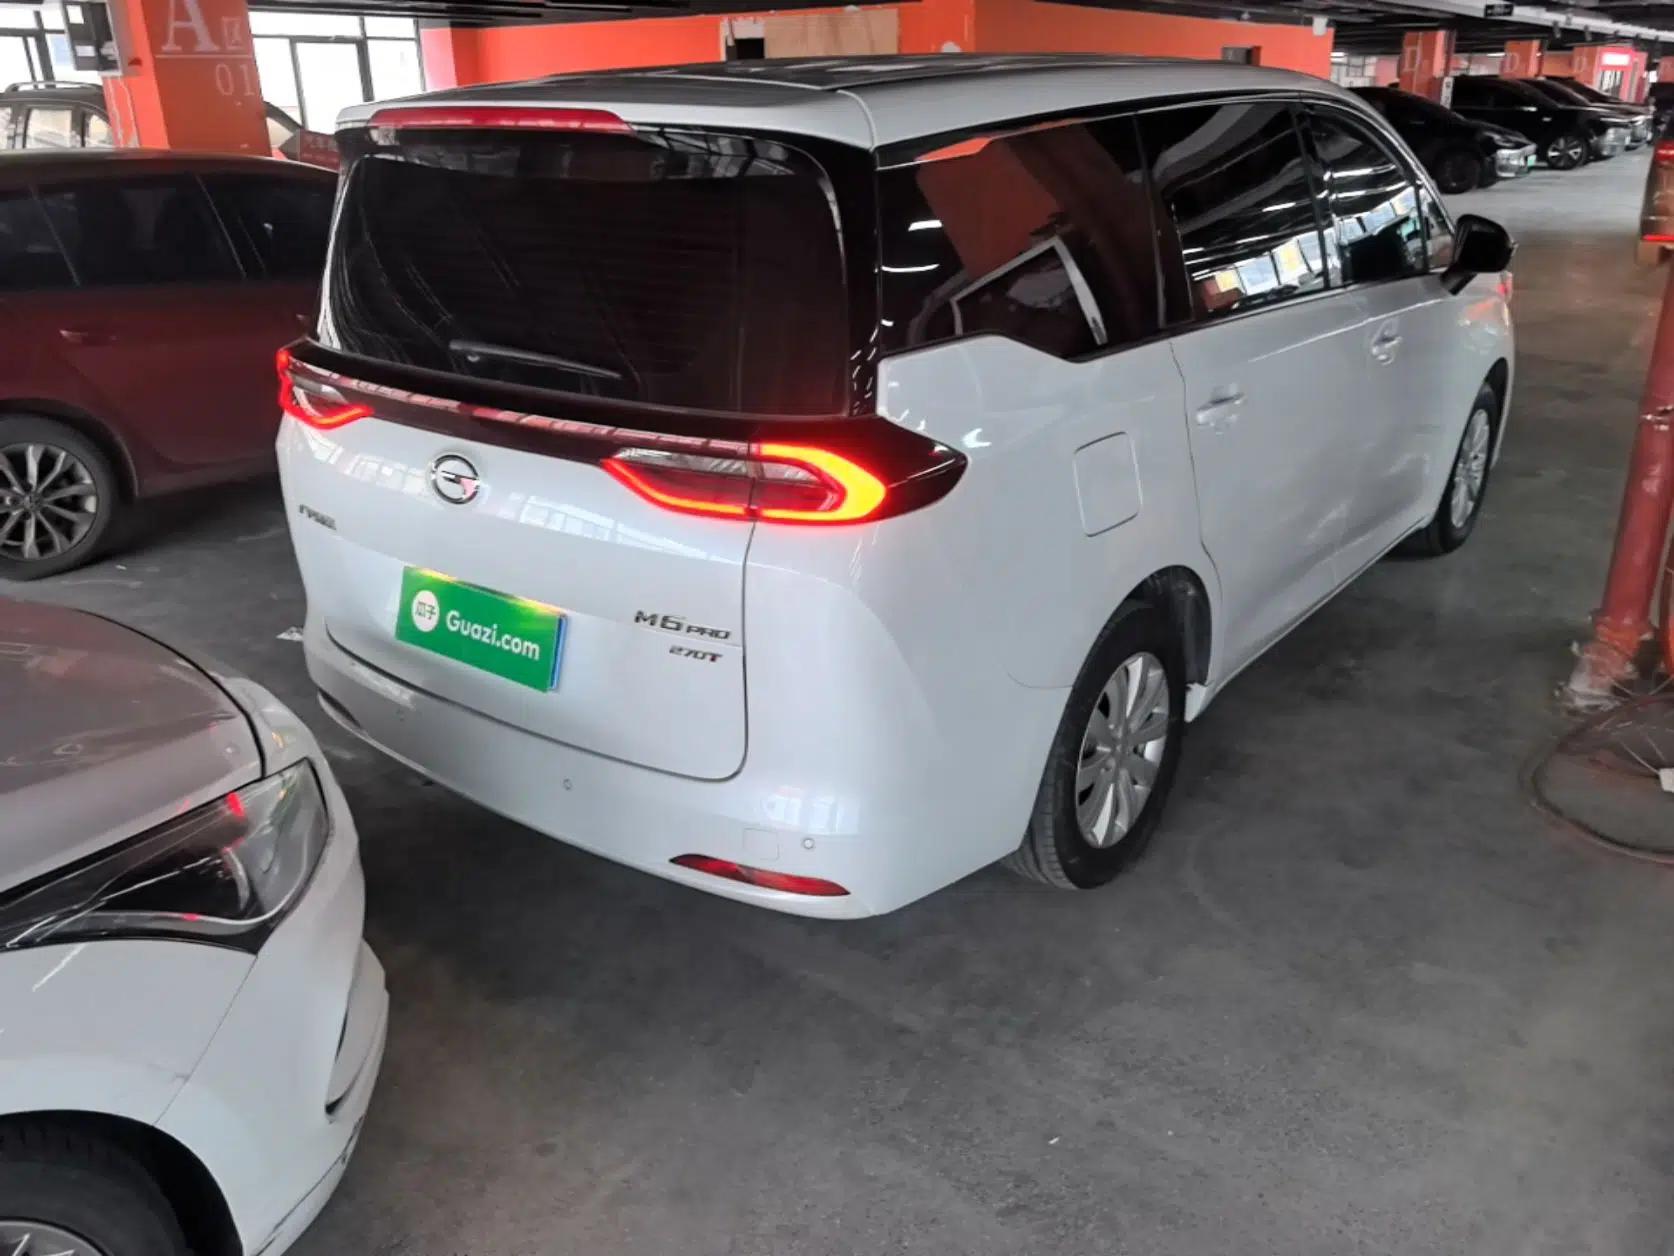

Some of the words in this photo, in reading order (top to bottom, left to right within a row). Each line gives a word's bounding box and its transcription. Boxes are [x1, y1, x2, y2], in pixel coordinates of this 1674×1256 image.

[215, 62, 256, 96] 01
[446, 609, 540, 661] Guazi.com
[669, 645, 723, 662] 270T
